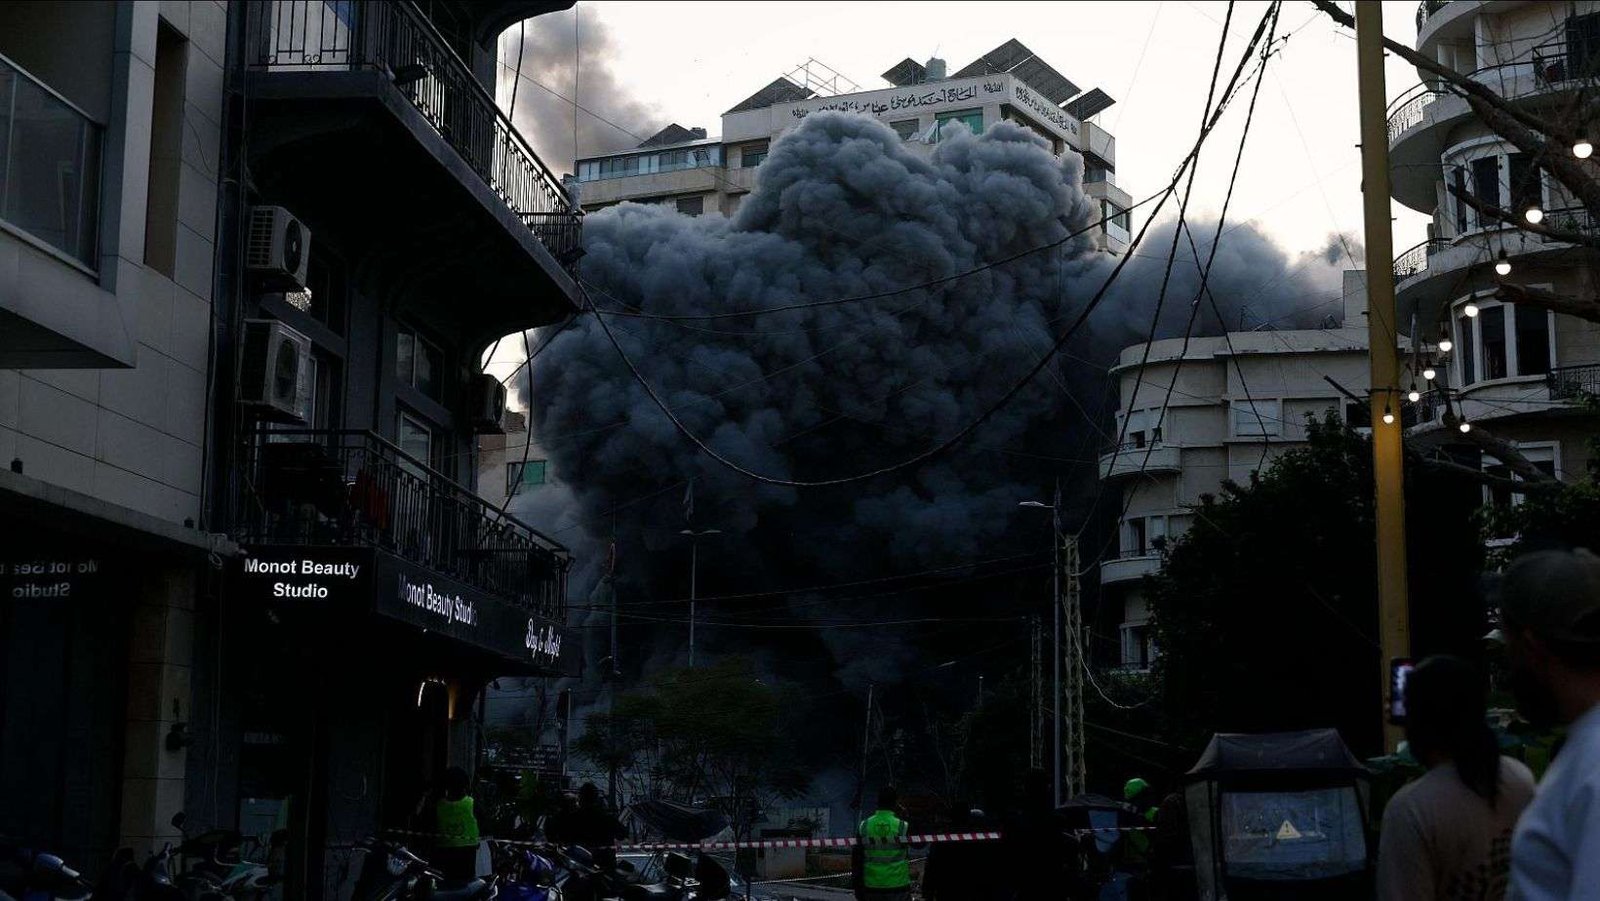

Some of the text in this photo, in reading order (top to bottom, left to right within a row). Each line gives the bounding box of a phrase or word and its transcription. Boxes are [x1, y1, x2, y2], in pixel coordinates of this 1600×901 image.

[244, 558, 360, 579] Monot Beauty
[273, 582, 329, 599] Studio
[398, 573, 478, 628] Monot Beauty Studio
[525, 616, 538, 659] Day
[544, 625, 561, 663] Night
